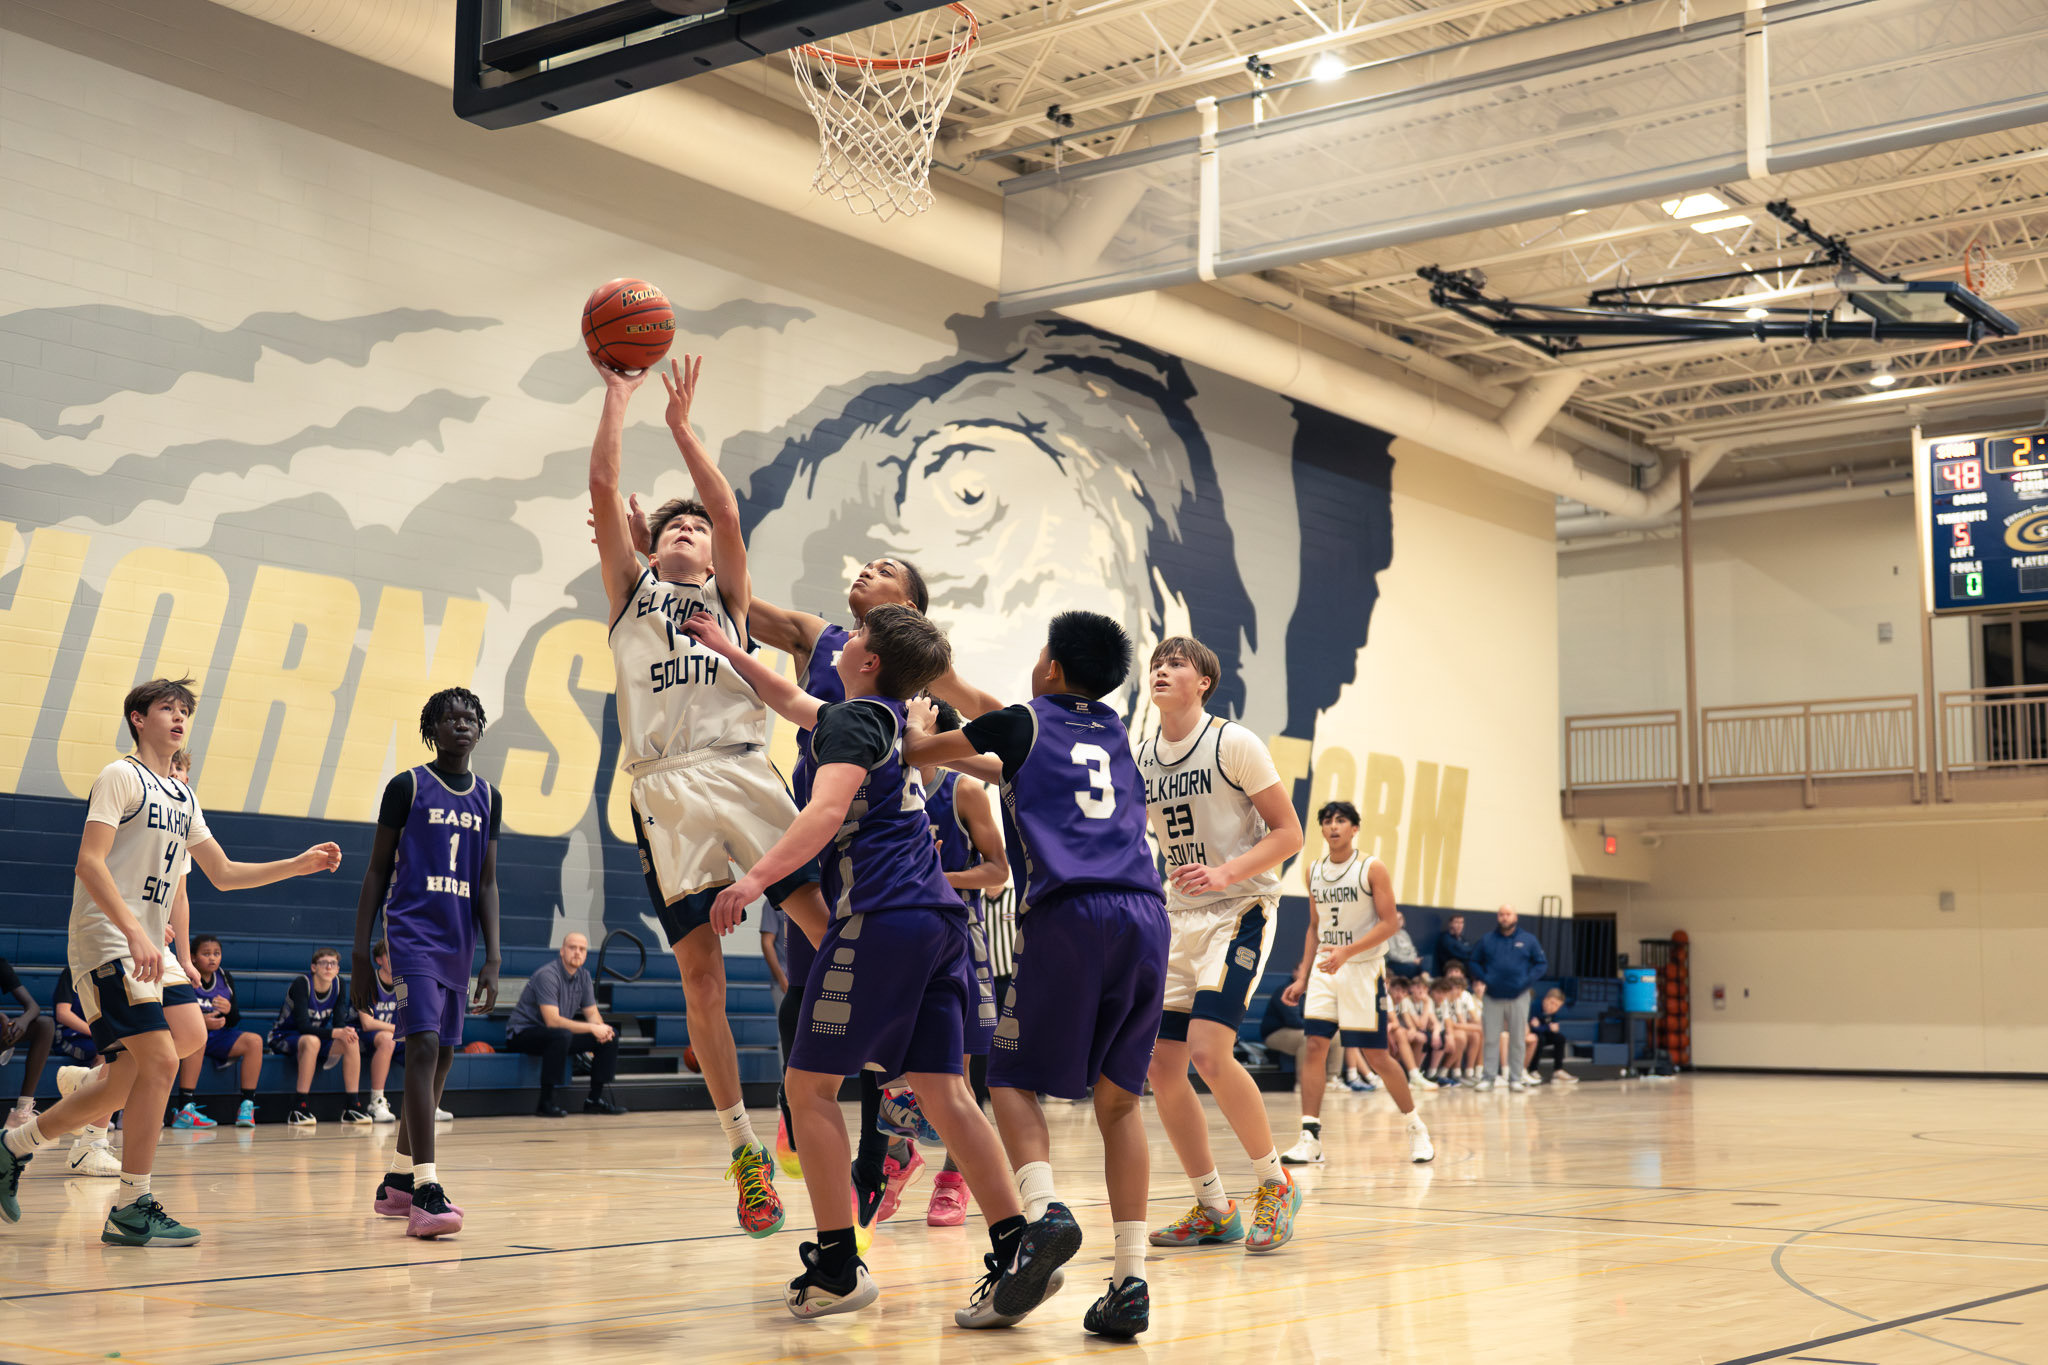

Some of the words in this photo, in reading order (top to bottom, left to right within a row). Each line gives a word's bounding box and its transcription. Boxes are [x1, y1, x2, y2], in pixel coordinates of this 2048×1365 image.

[1942, 460, 1982, 490] 48
[1953, 523, 1971, 547] 5
[1950, 546, 1974, 558] LEFT
[1950, 560, 1983, 573] FOULS
[1966, 572, 1982, 596] 0
[650, 654, 719, 694] SOUTH
[1070, 742, 1117, 819] 3
[428, 808, 482, 832] EAST
[1162, 803, 1195, 839] 23
[1268, 735, 1470, 908] TORM
[164, 840, 179, 874] 4
[449, 832, 461, 872] 1
[426, 875, 471, 898] HIGH
[1312, 886, 1359, 904] ELKHORN
